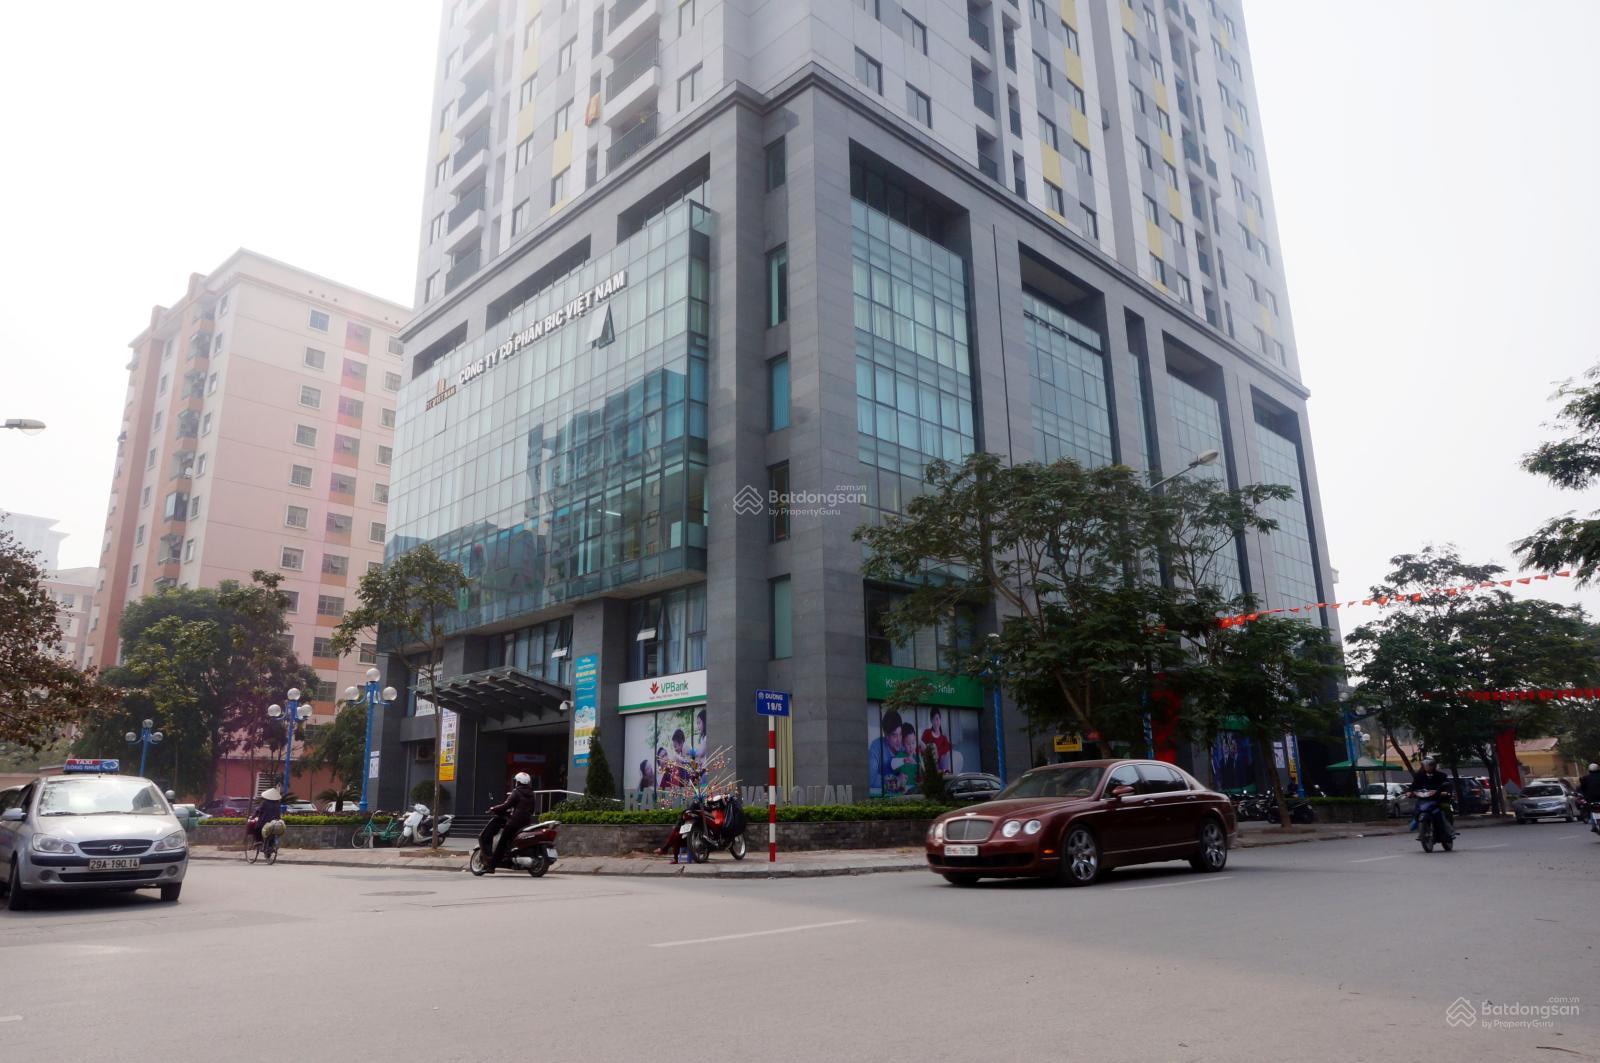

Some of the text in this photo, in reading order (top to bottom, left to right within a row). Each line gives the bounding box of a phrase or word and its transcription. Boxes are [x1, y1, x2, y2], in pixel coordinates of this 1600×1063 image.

[459, 359, 486, 385] CÔNG
[485, 348, 501, 369] TY
[544, 309, 567, 334] BIC
[595, 270, 628, 303] NAM
[660, 680, 689, 694] VPBank
[767, 702, 783, 711] 19/5
